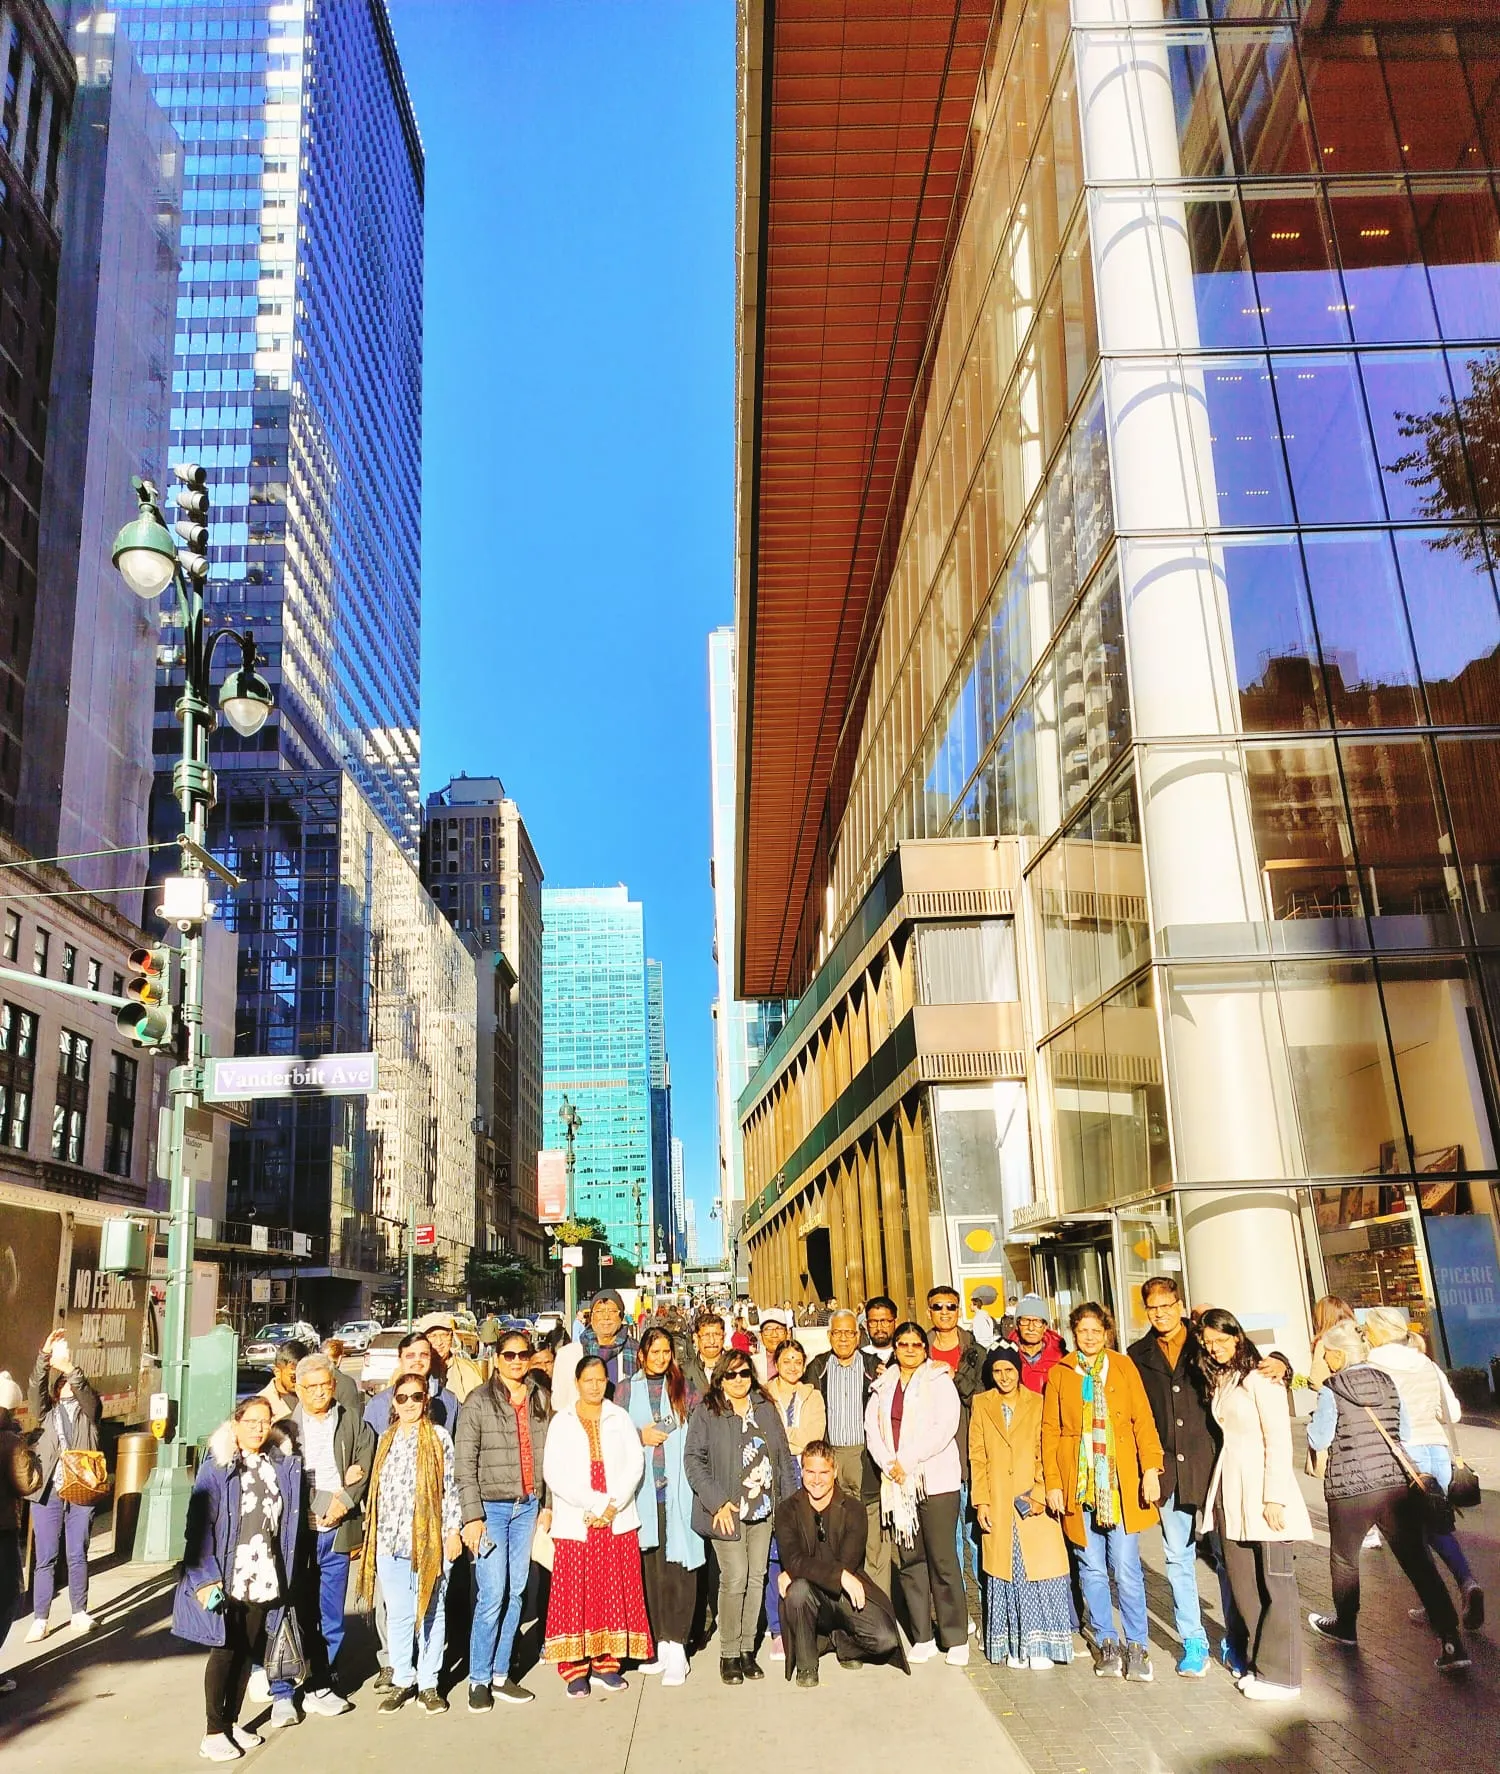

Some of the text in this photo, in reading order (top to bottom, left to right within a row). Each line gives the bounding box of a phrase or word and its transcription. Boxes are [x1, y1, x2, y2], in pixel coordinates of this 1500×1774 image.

[219, 1067, 369, 1088] Vanderbilt Ave
[73, 1269, 91, 1309] NO
[80, 1313, 101, 1344] JUST
